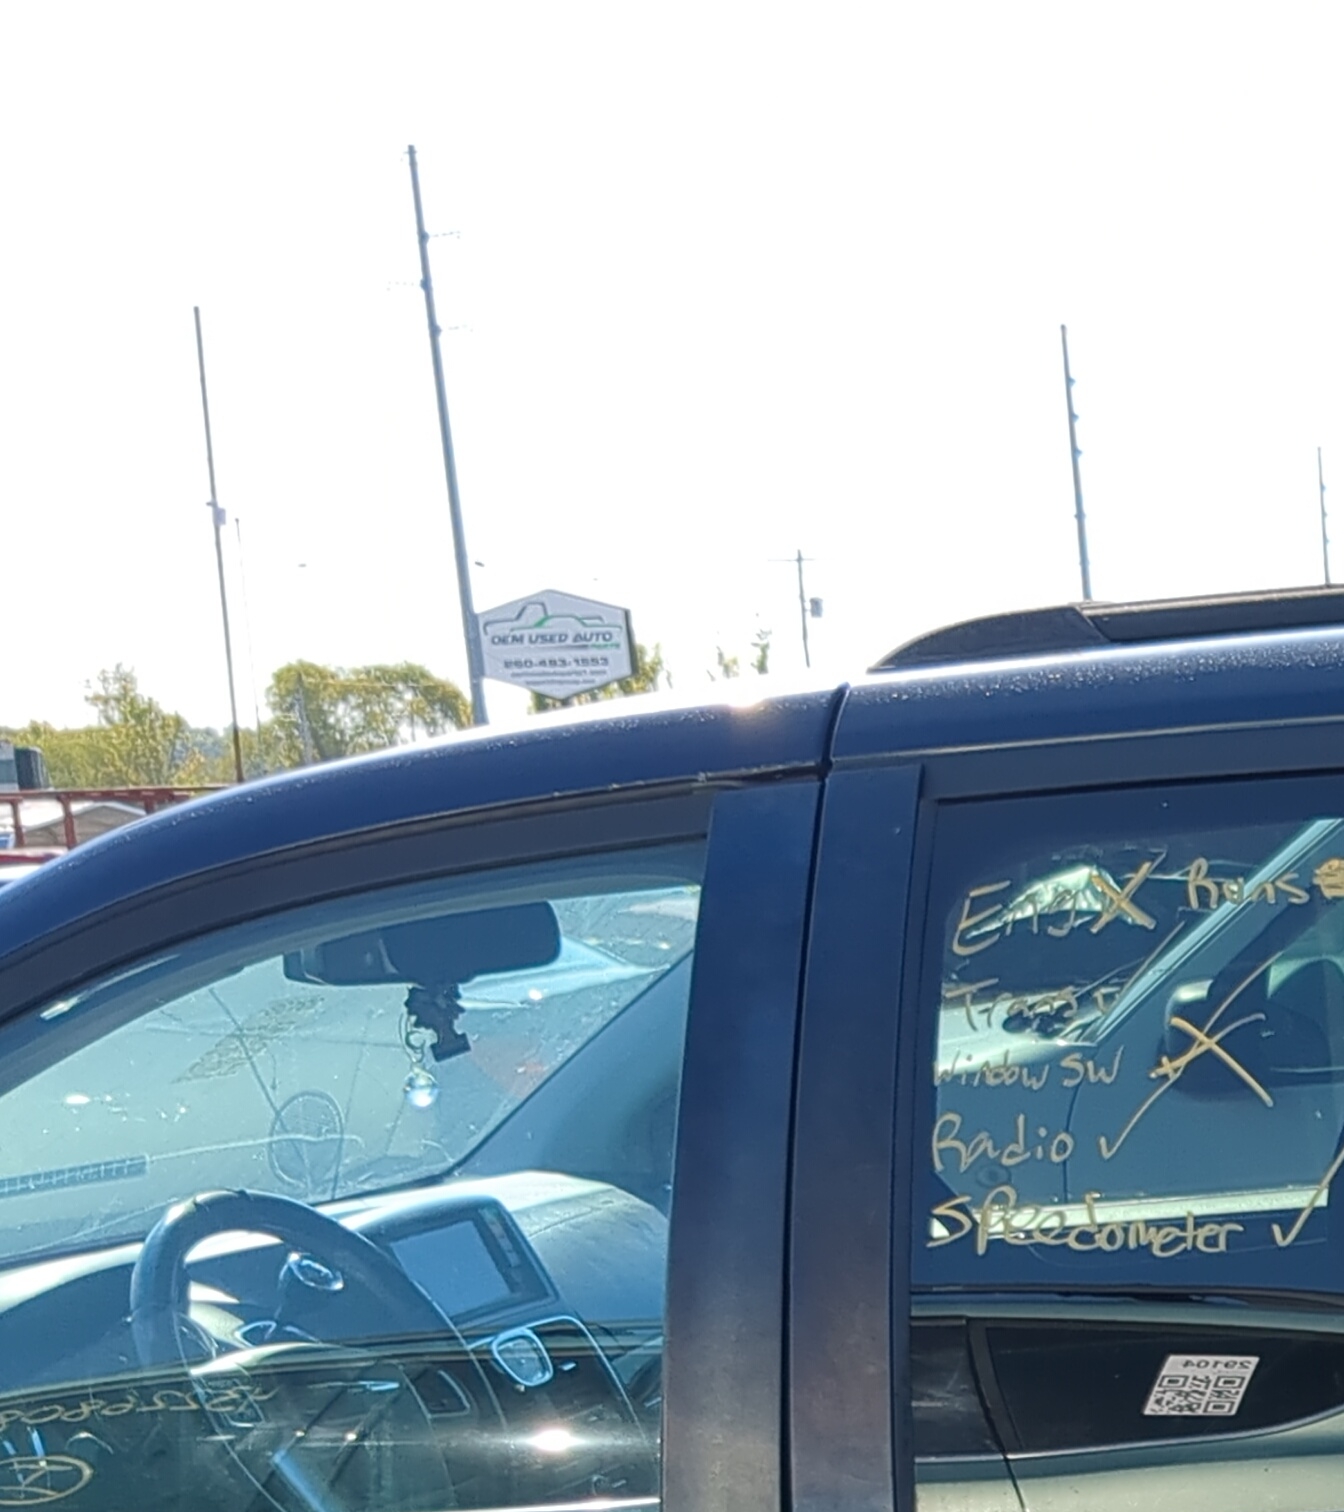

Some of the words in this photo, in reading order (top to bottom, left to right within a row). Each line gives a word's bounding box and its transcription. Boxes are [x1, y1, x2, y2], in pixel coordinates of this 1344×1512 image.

[491, 634, 524, 645] OEM
[528, 632, 568, 644] USED
[572, 631, 613, 643] AUTO
[932, 1114, 1075, 1172] Radio
